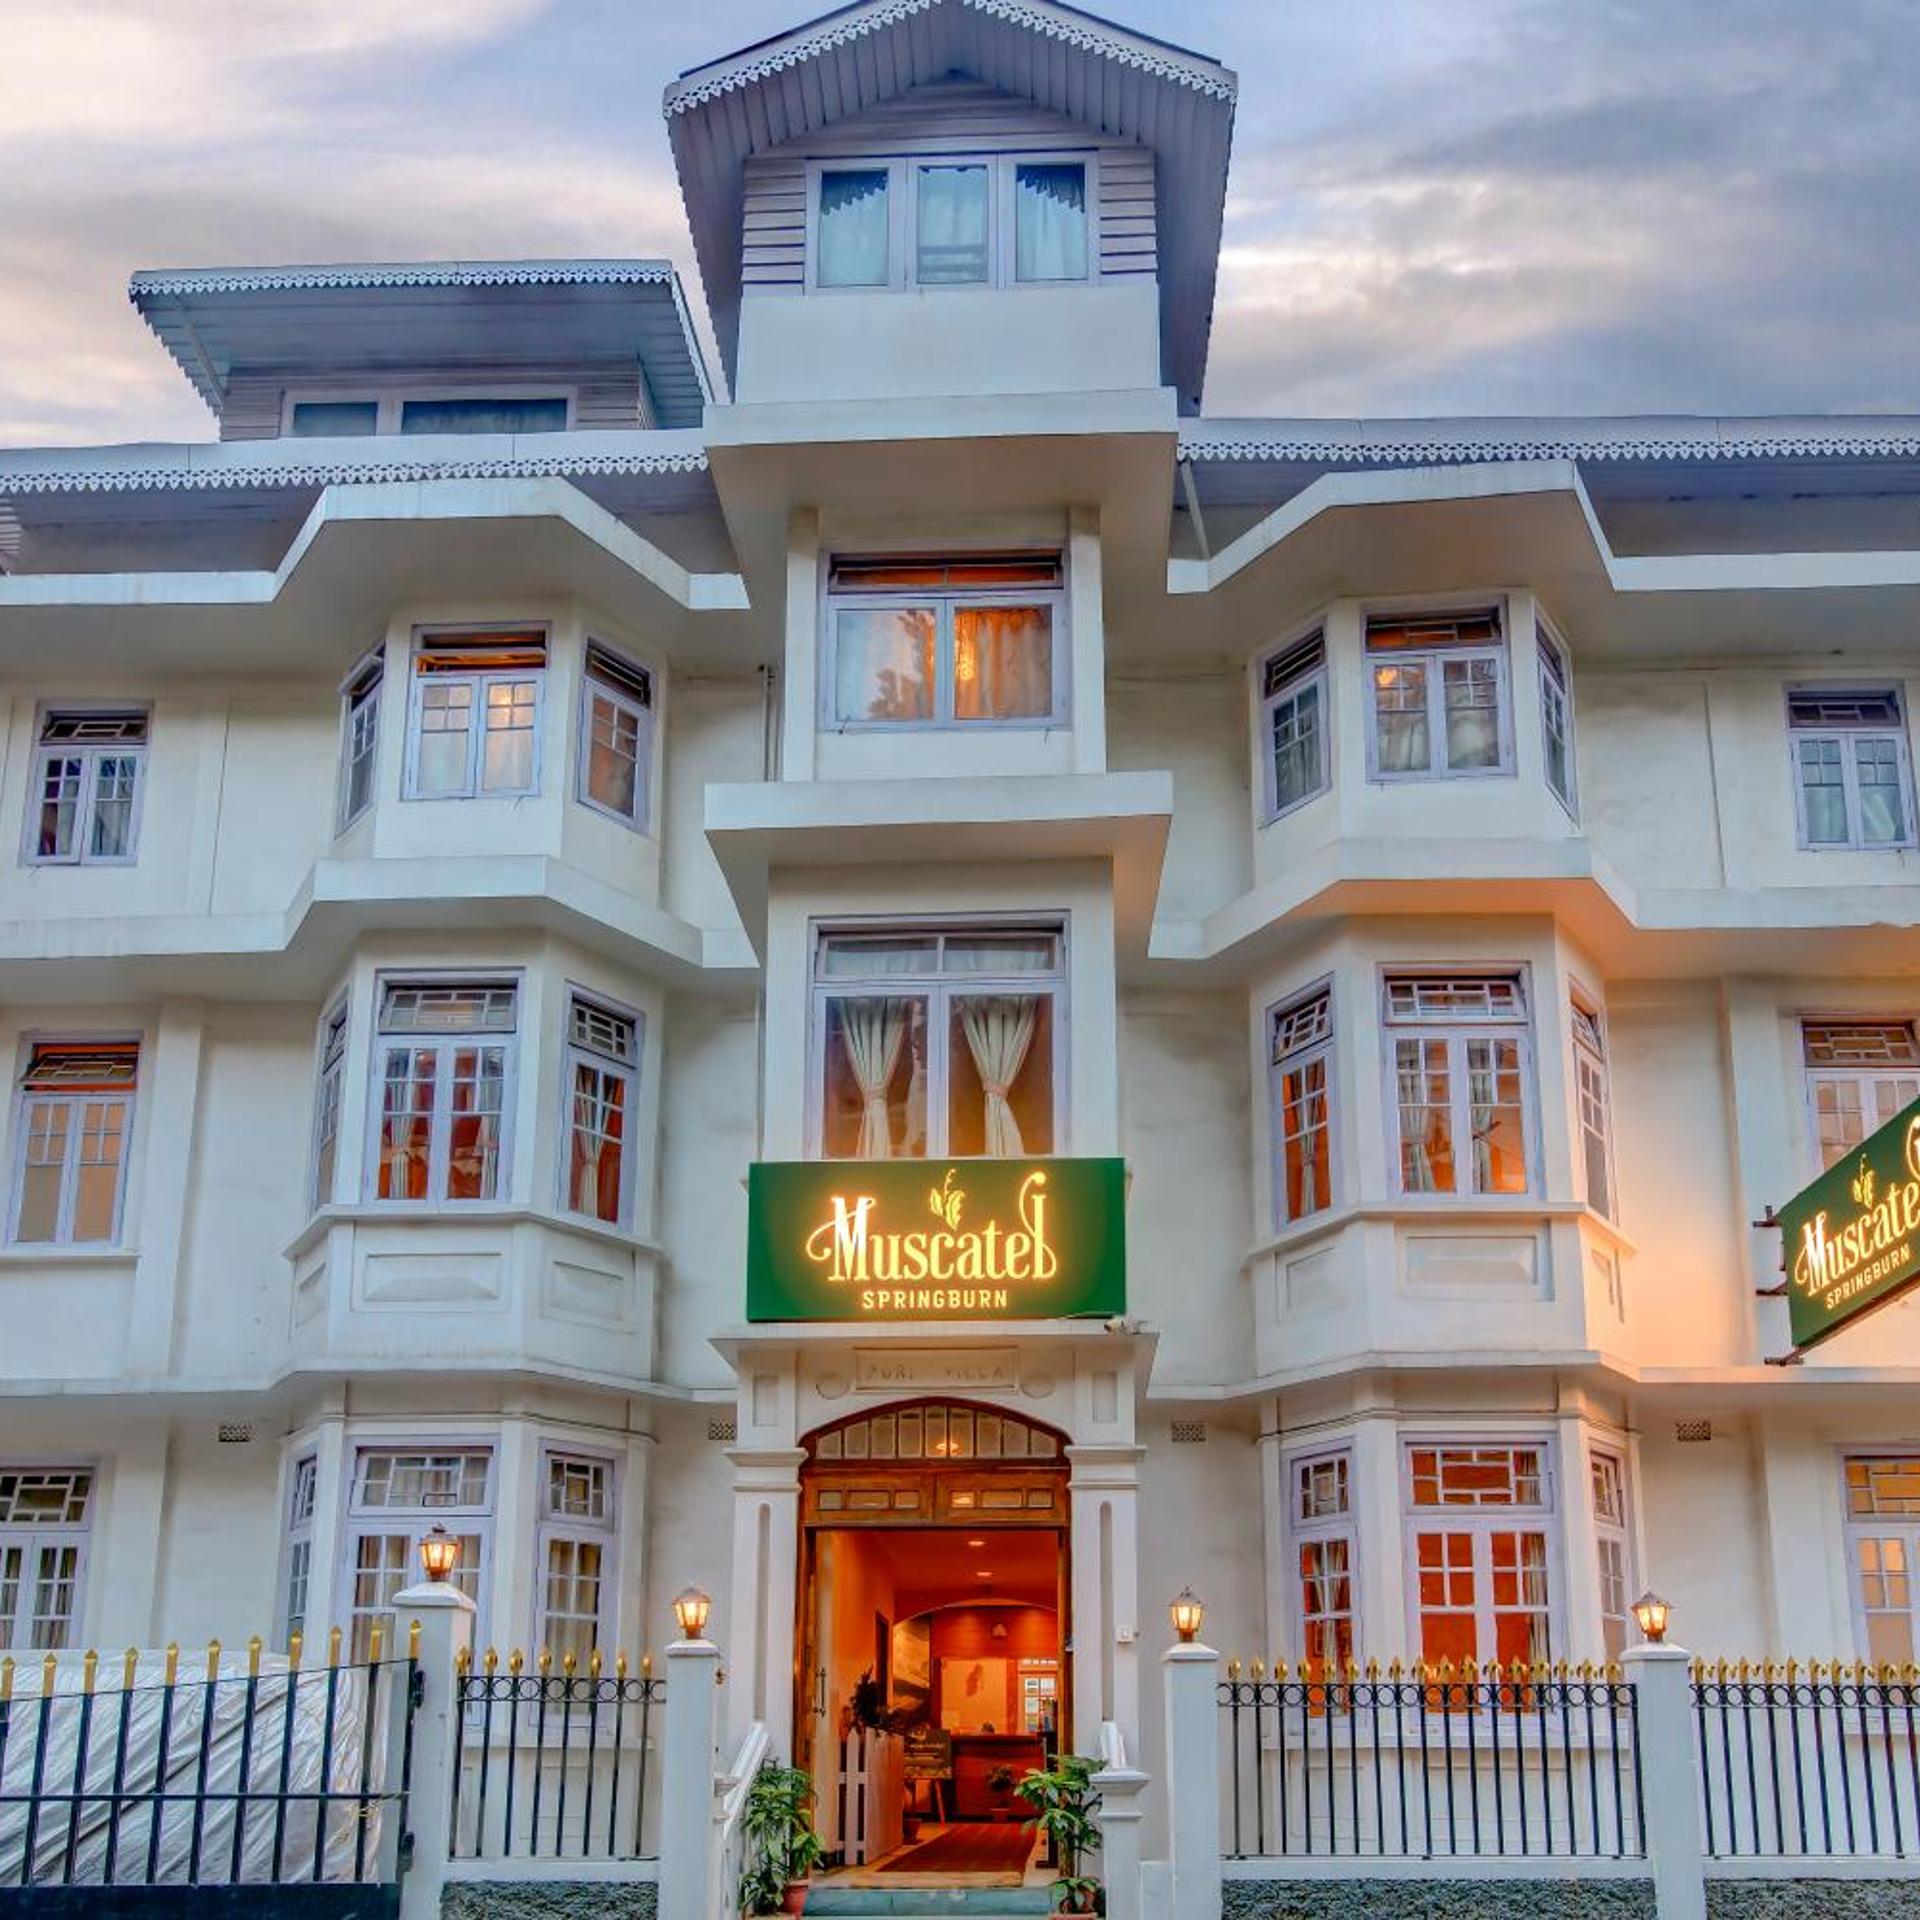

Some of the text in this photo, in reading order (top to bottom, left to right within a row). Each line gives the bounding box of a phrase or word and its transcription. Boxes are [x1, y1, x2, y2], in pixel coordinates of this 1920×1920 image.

[806, 1171, 1058, 1281] Muscatel
[862, 1290, 1008, 1309] SPRINGBURN
[1826, 1242, 1911, 1310] SPRINGBURN
